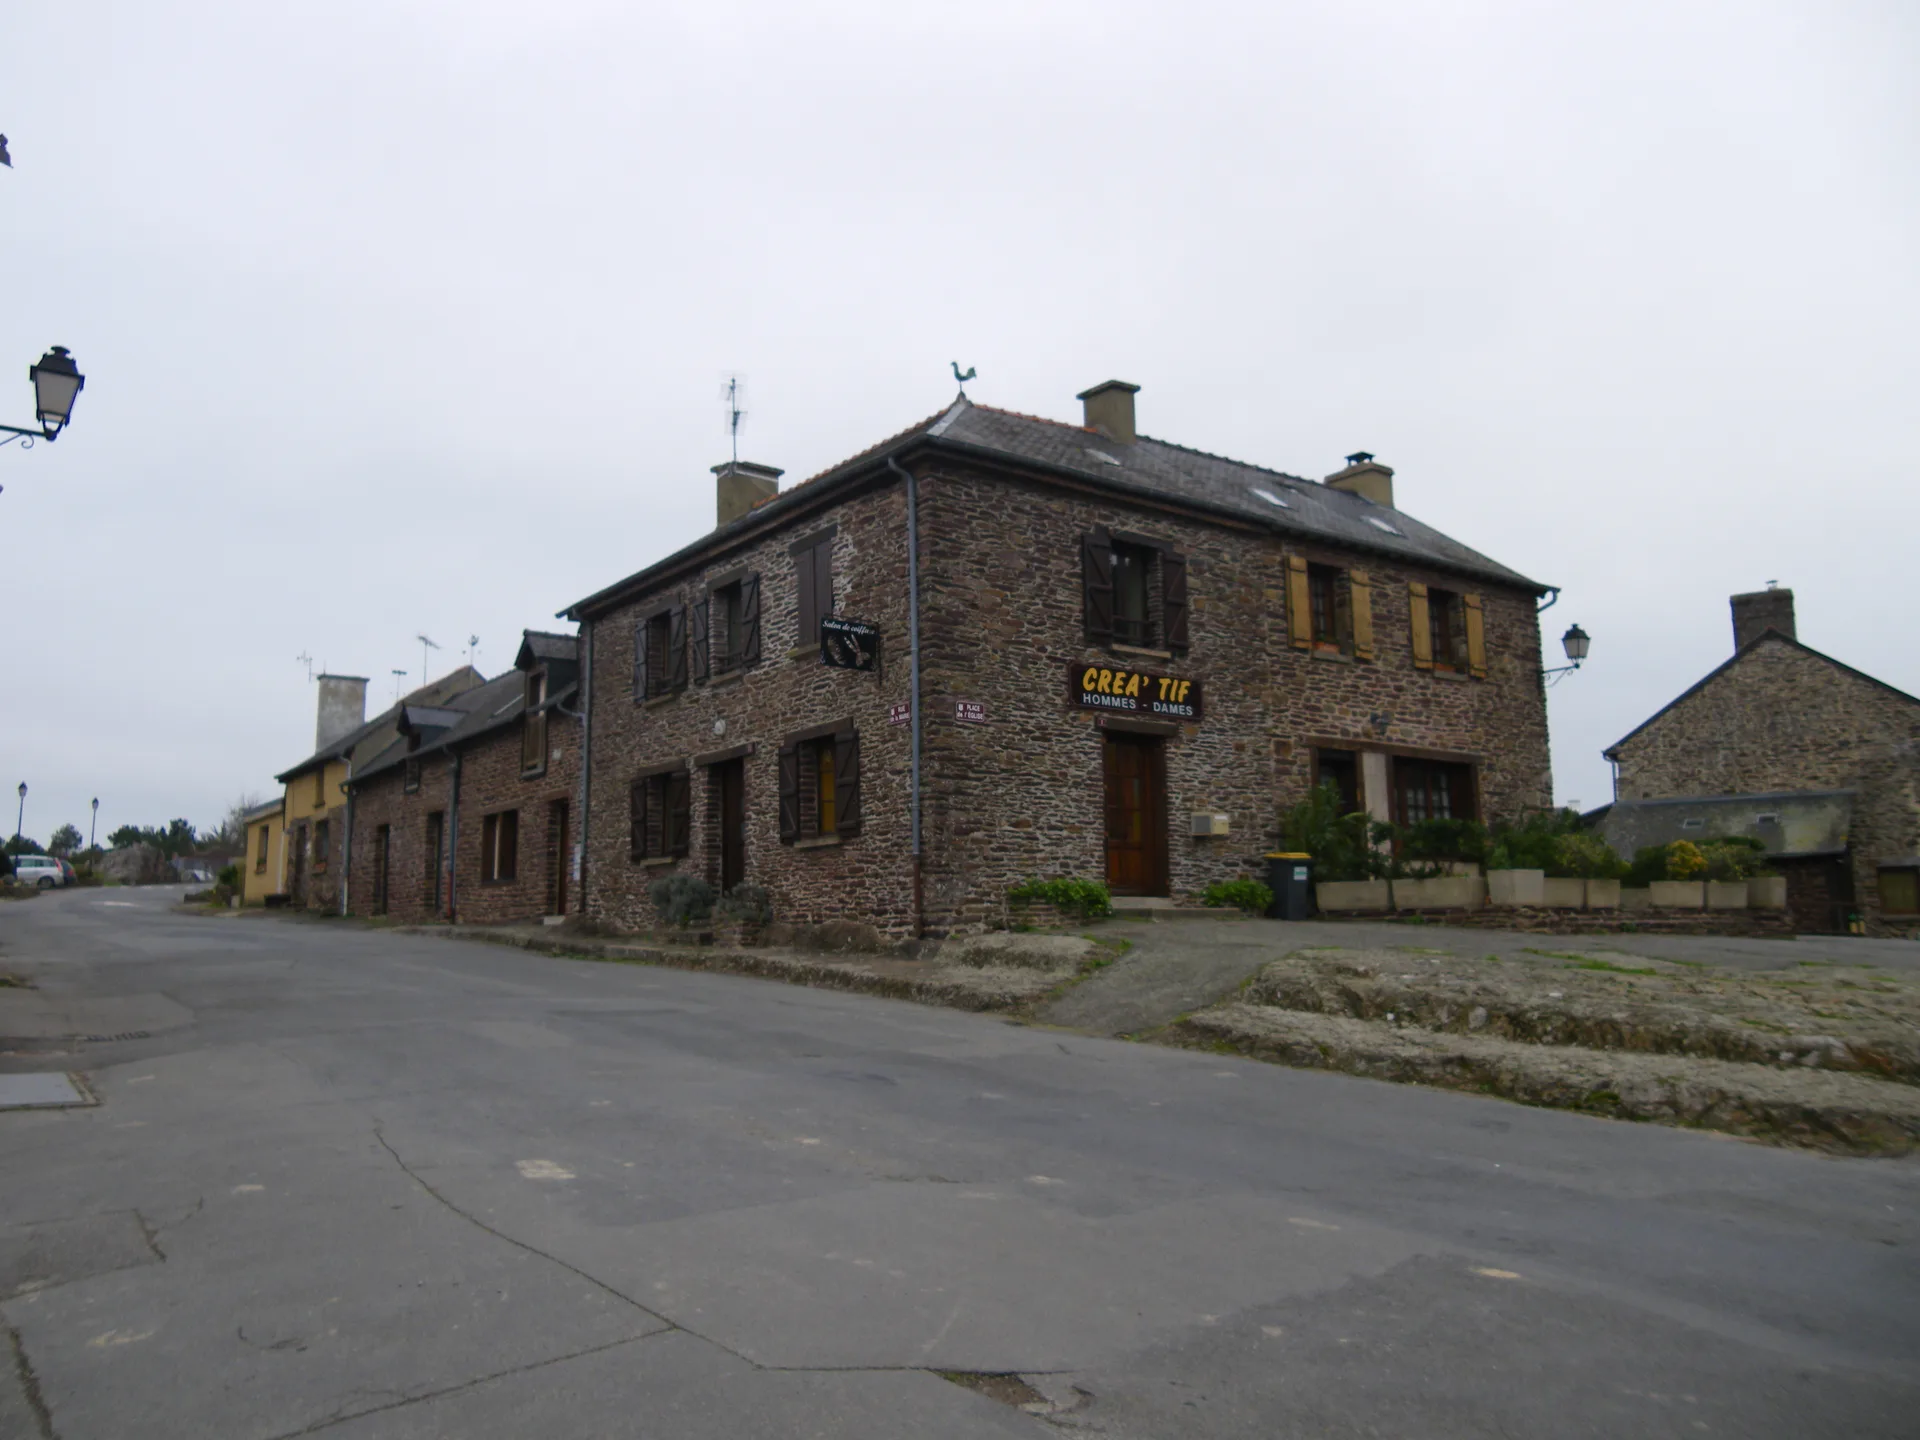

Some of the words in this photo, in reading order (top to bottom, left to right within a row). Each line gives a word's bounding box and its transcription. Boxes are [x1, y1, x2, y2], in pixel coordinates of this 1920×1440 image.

[822, 620, 841, 630] Salon
[842, 623, 850, 631] de
[1082, 667, 1150, 697] CREA'
[1158, 678, 1191, 703] TIF
[966, 704, 980, 712] PLACE
[1083, 693, 1136, 709] HOMMES
[1153, 702, 1193, 716] DAMES
